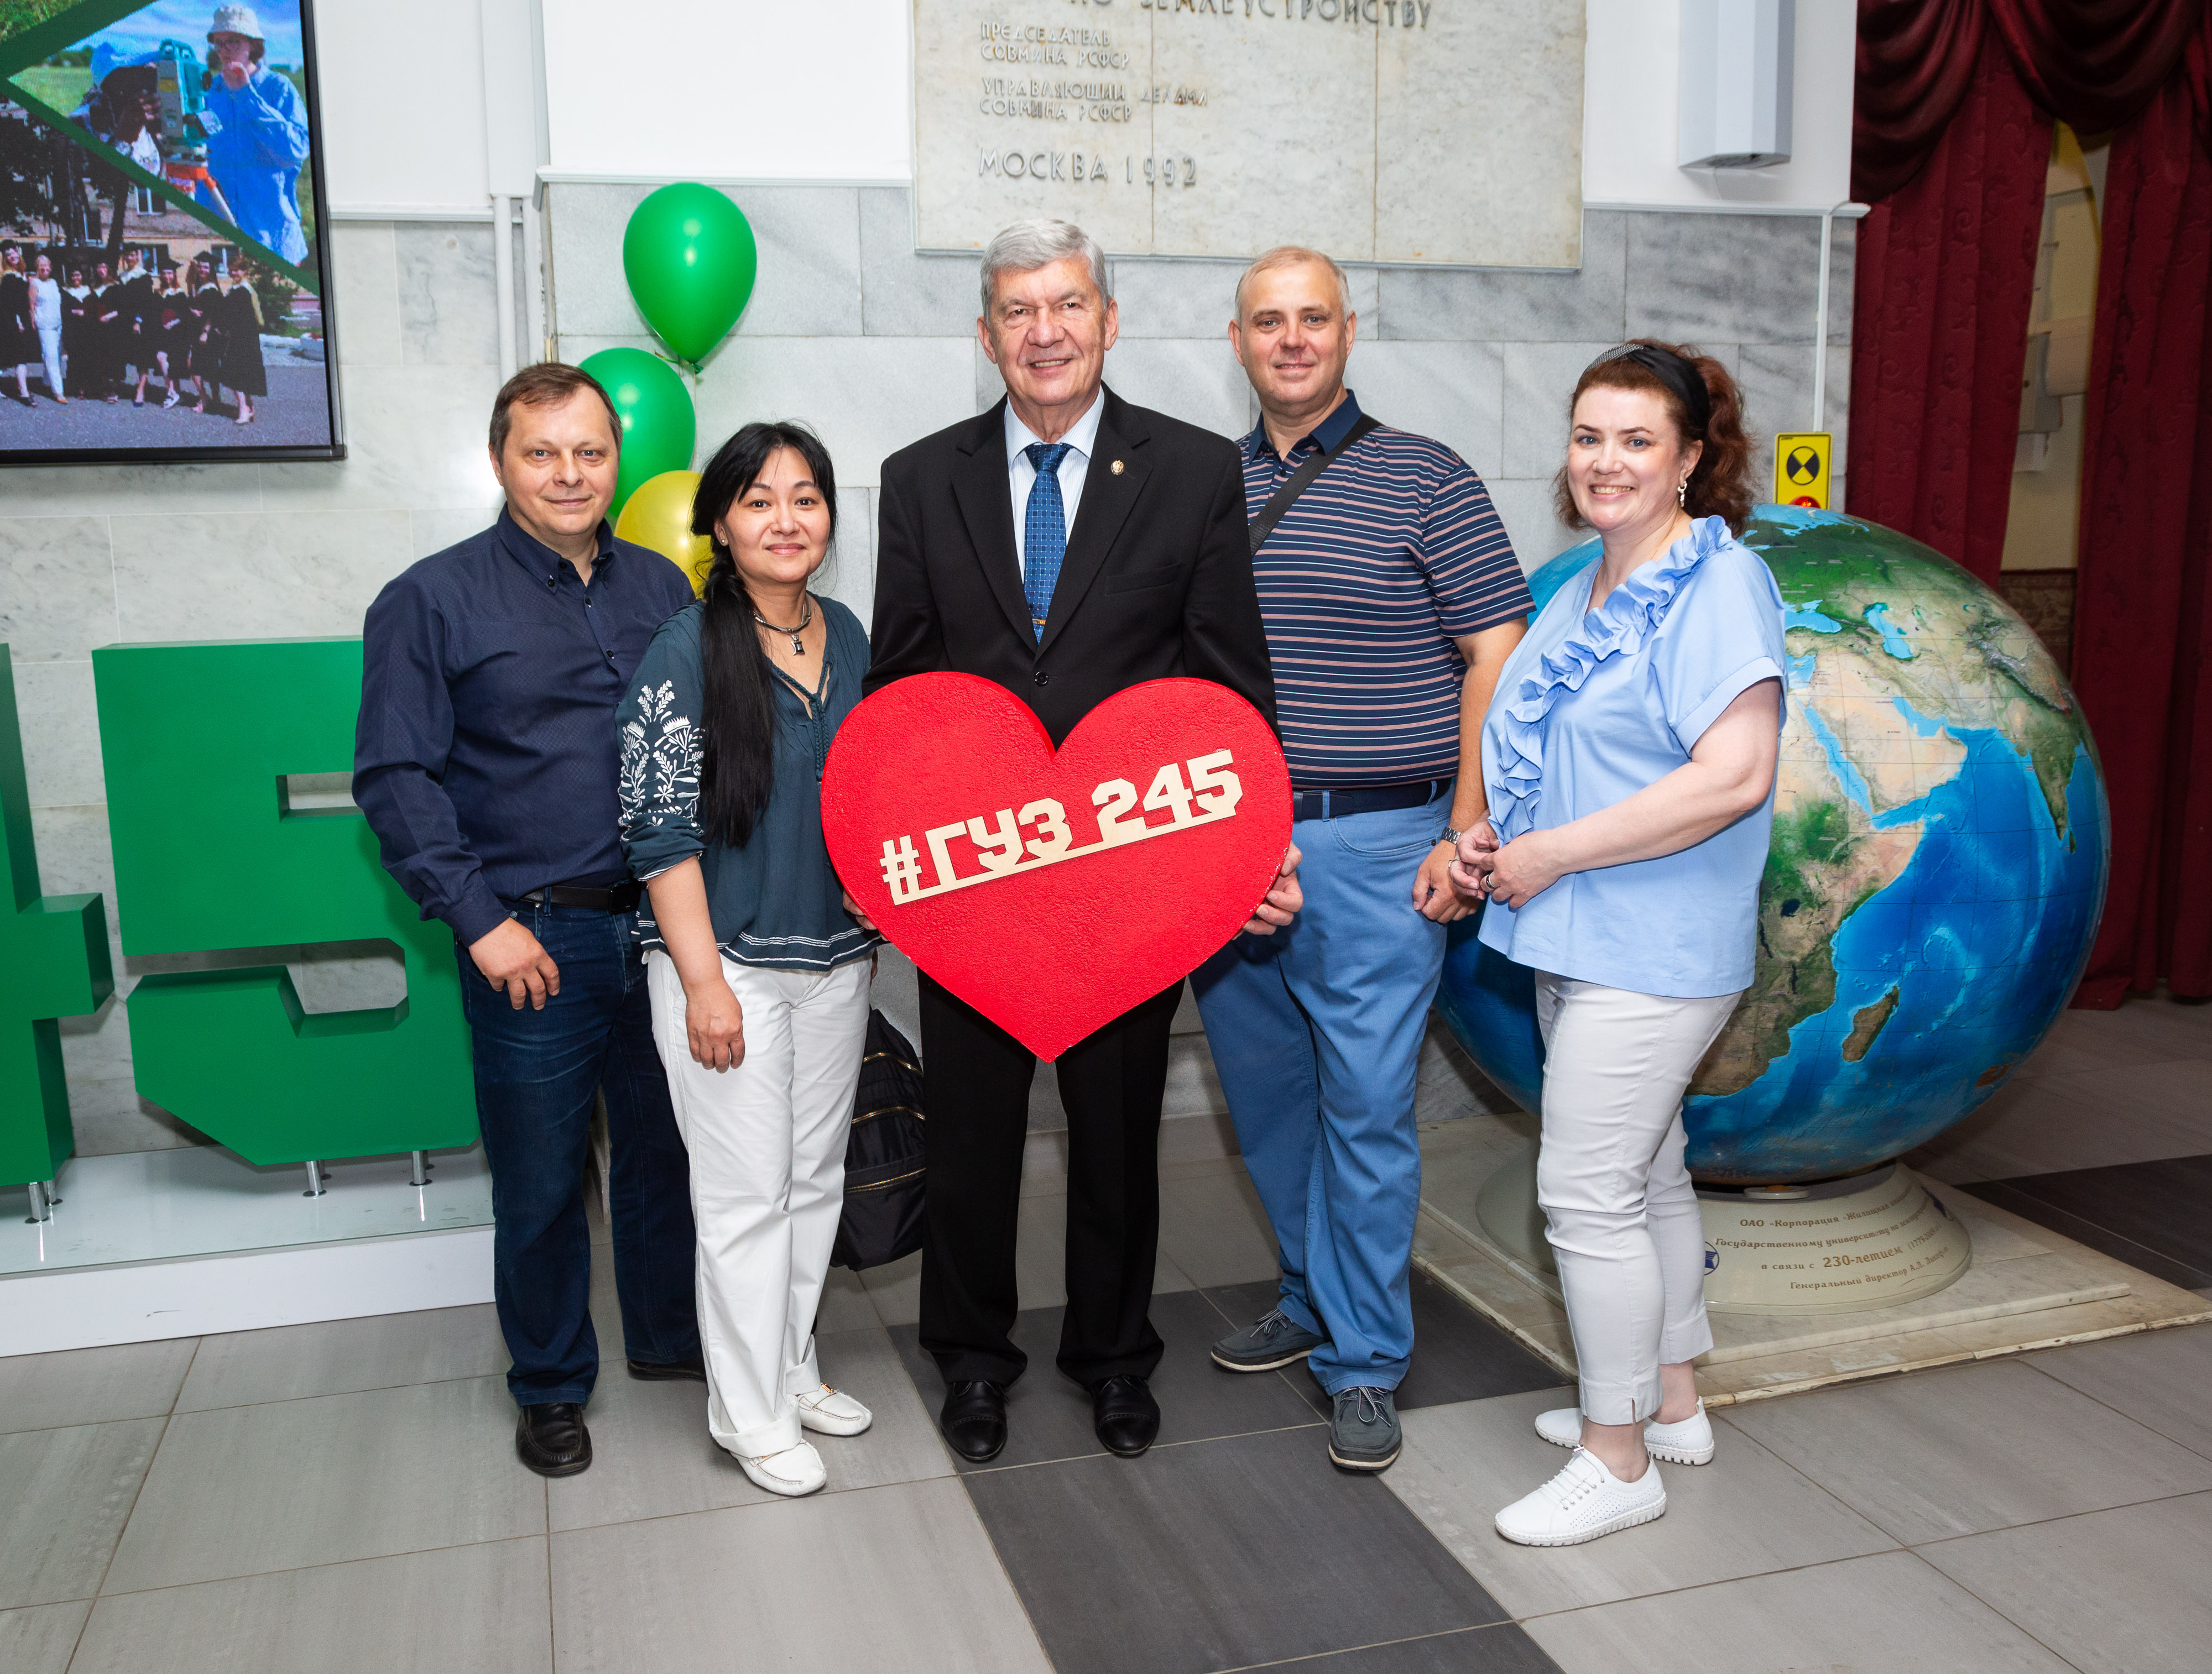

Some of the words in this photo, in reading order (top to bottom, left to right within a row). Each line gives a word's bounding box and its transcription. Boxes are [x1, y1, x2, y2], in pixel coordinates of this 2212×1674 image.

[981, 21, 1110, 46] ПРЕДСЕДАТЕЛЬ
[981, 43, 1067, 65] СОВМИНА
[1077, 50, 1129, 69] РСФСР
[1140, 86, 1207, 106] ДЕЛАМИ
[980, 97, 1067, 120] СОВМИНА
[1079, 104, 1132, 122] РСФСР
[979, 147, 1107, 181] МОСКВА
[1126, 156, 1196, 186] 1992
[879, 797, 1073, 906] #ГУЗ
[1091, 749, 1244, 852] 245
[1715, 1238, 1823, 1249] Государственному
[1825, 1228, 1891, 1247] университету
[1823, 1246, 1904, 1268] 230-летием
[1790, 1277, 1862, 1290] Генеральный
[1865, 1268, 1908, 1282] директор
